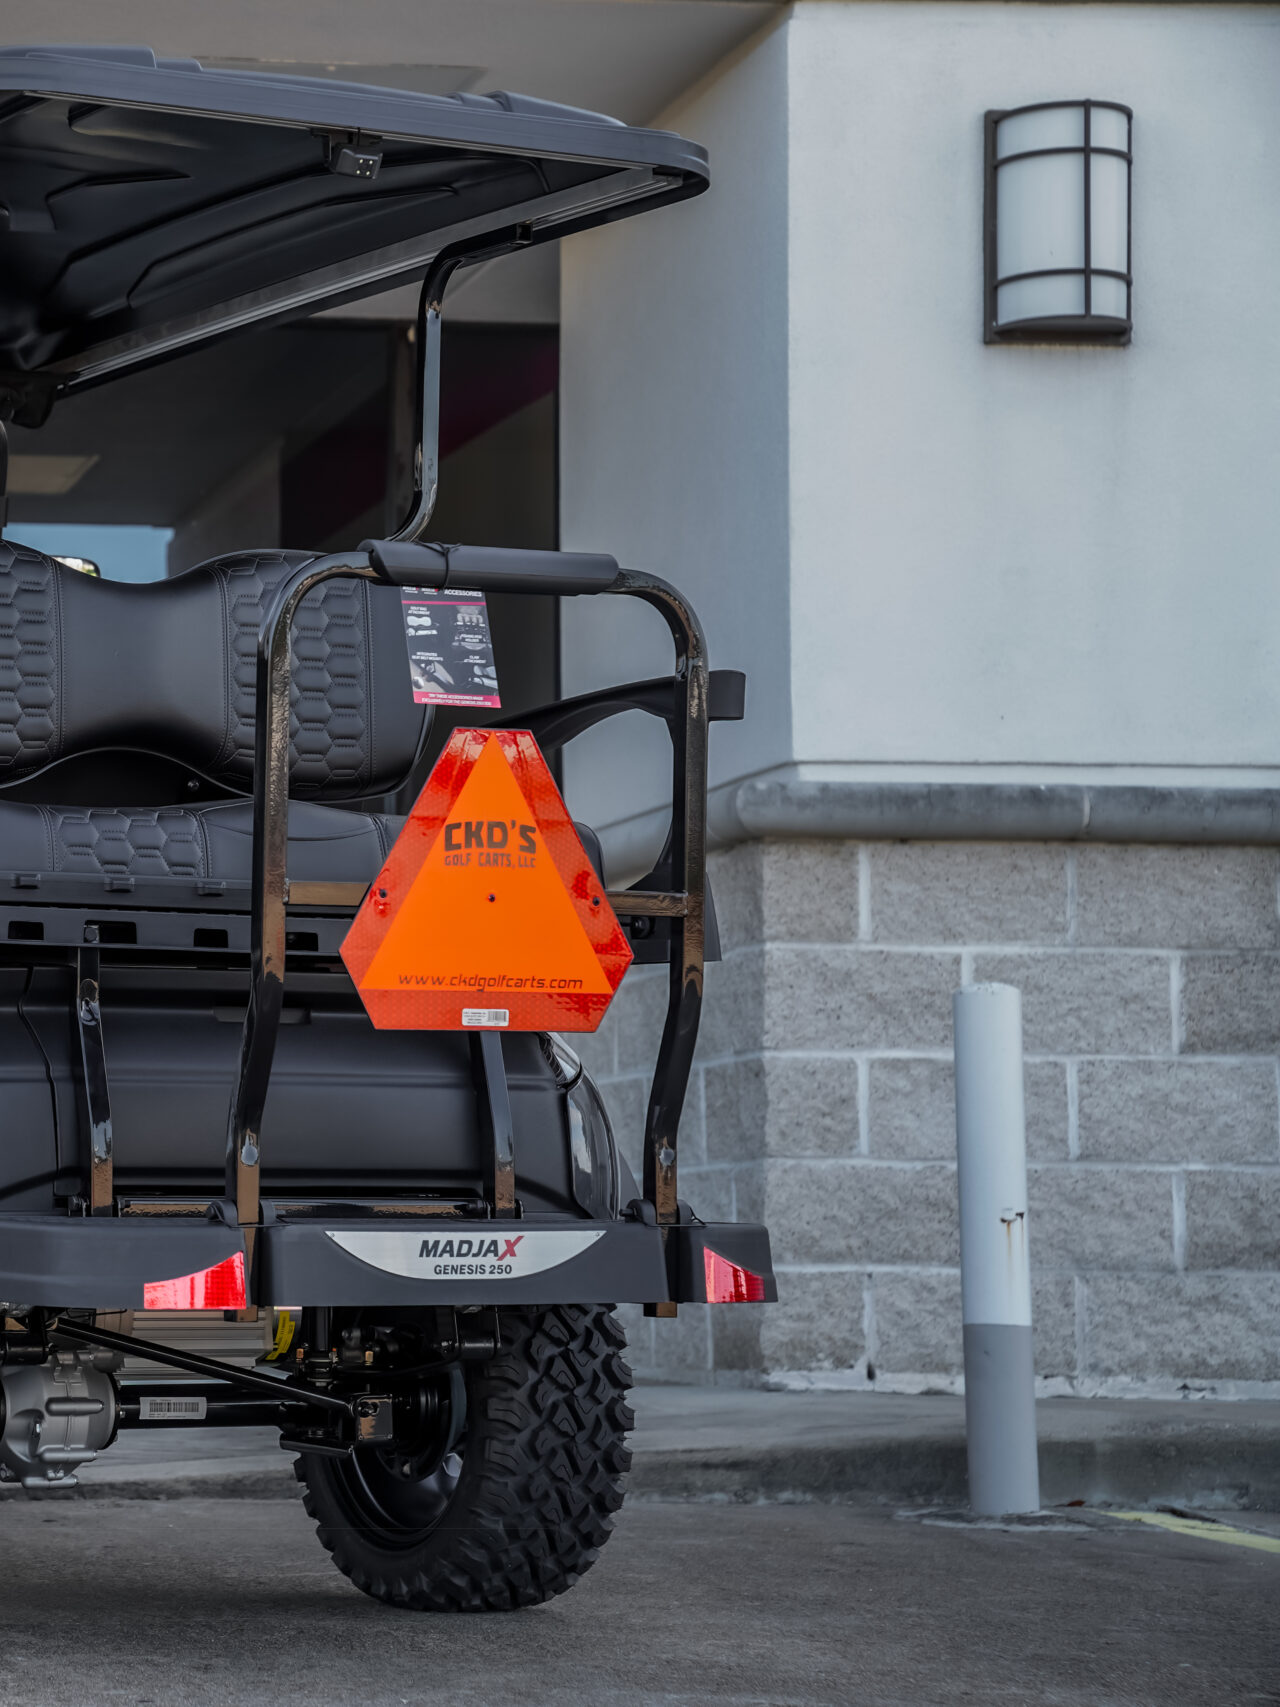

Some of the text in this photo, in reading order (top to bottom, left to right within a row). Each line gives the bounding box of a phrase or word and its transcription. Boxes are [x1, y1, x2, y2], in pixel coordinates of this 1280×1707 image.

[444, 819, 537, 854] CKD'S
[444, 852, 472, 866] GOLF
[518, 855, 537, 868] LLC
[398, 973, 584, 993] www.ckdgolfcarts.com
[418, 1235, 525, 1262] MADJAX
[433, 1264, 513, 1275] GENESIS 250
